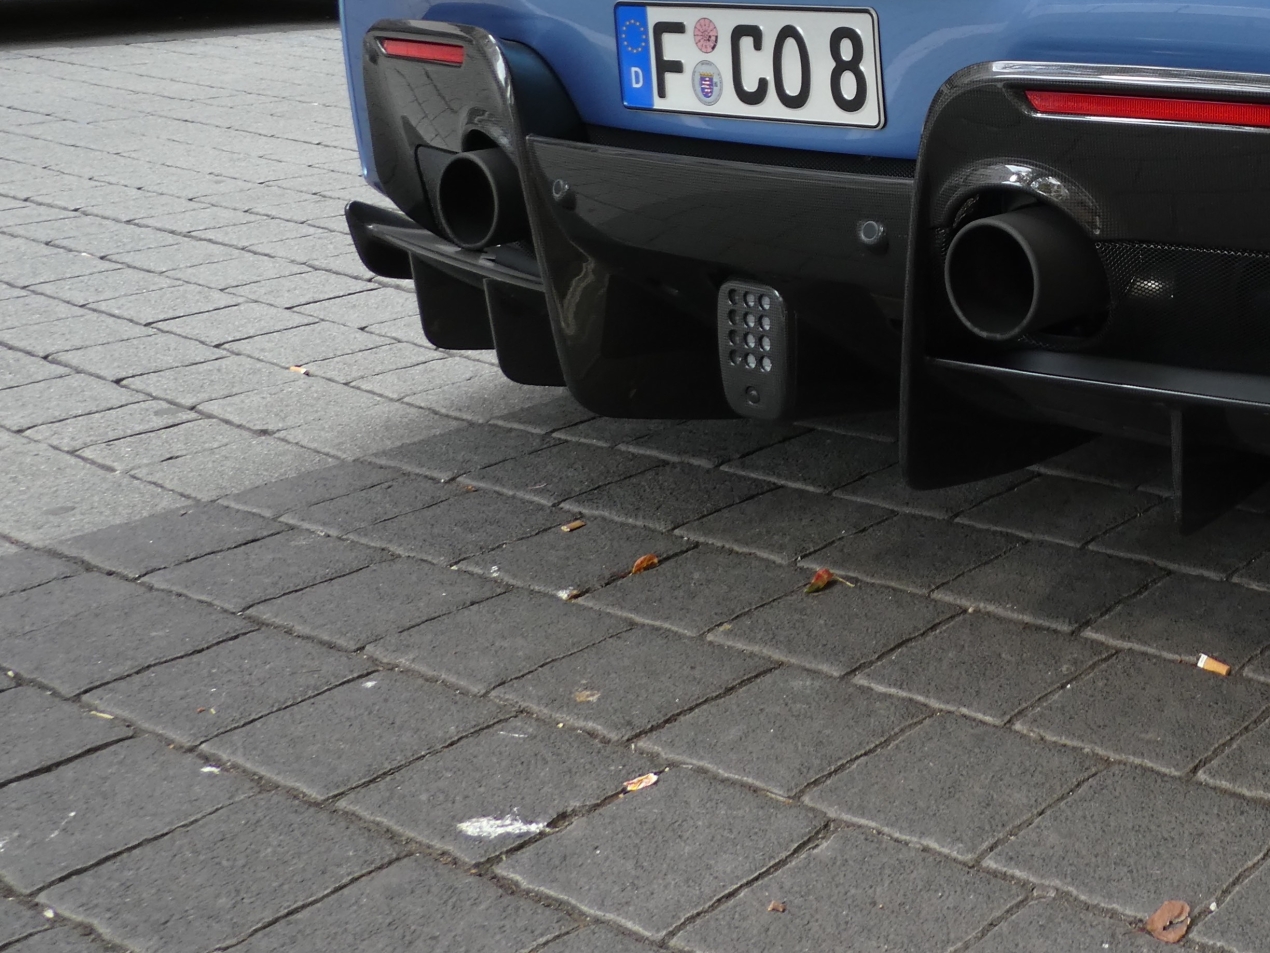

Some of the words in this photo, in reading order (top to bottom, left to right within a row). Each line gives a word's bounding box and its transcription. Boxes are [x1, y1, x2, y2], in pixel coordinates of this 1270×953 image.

[631, 66, 643, 88] D
[653, 21, 686, 99] F
[829, 26, 868, 113] 8
